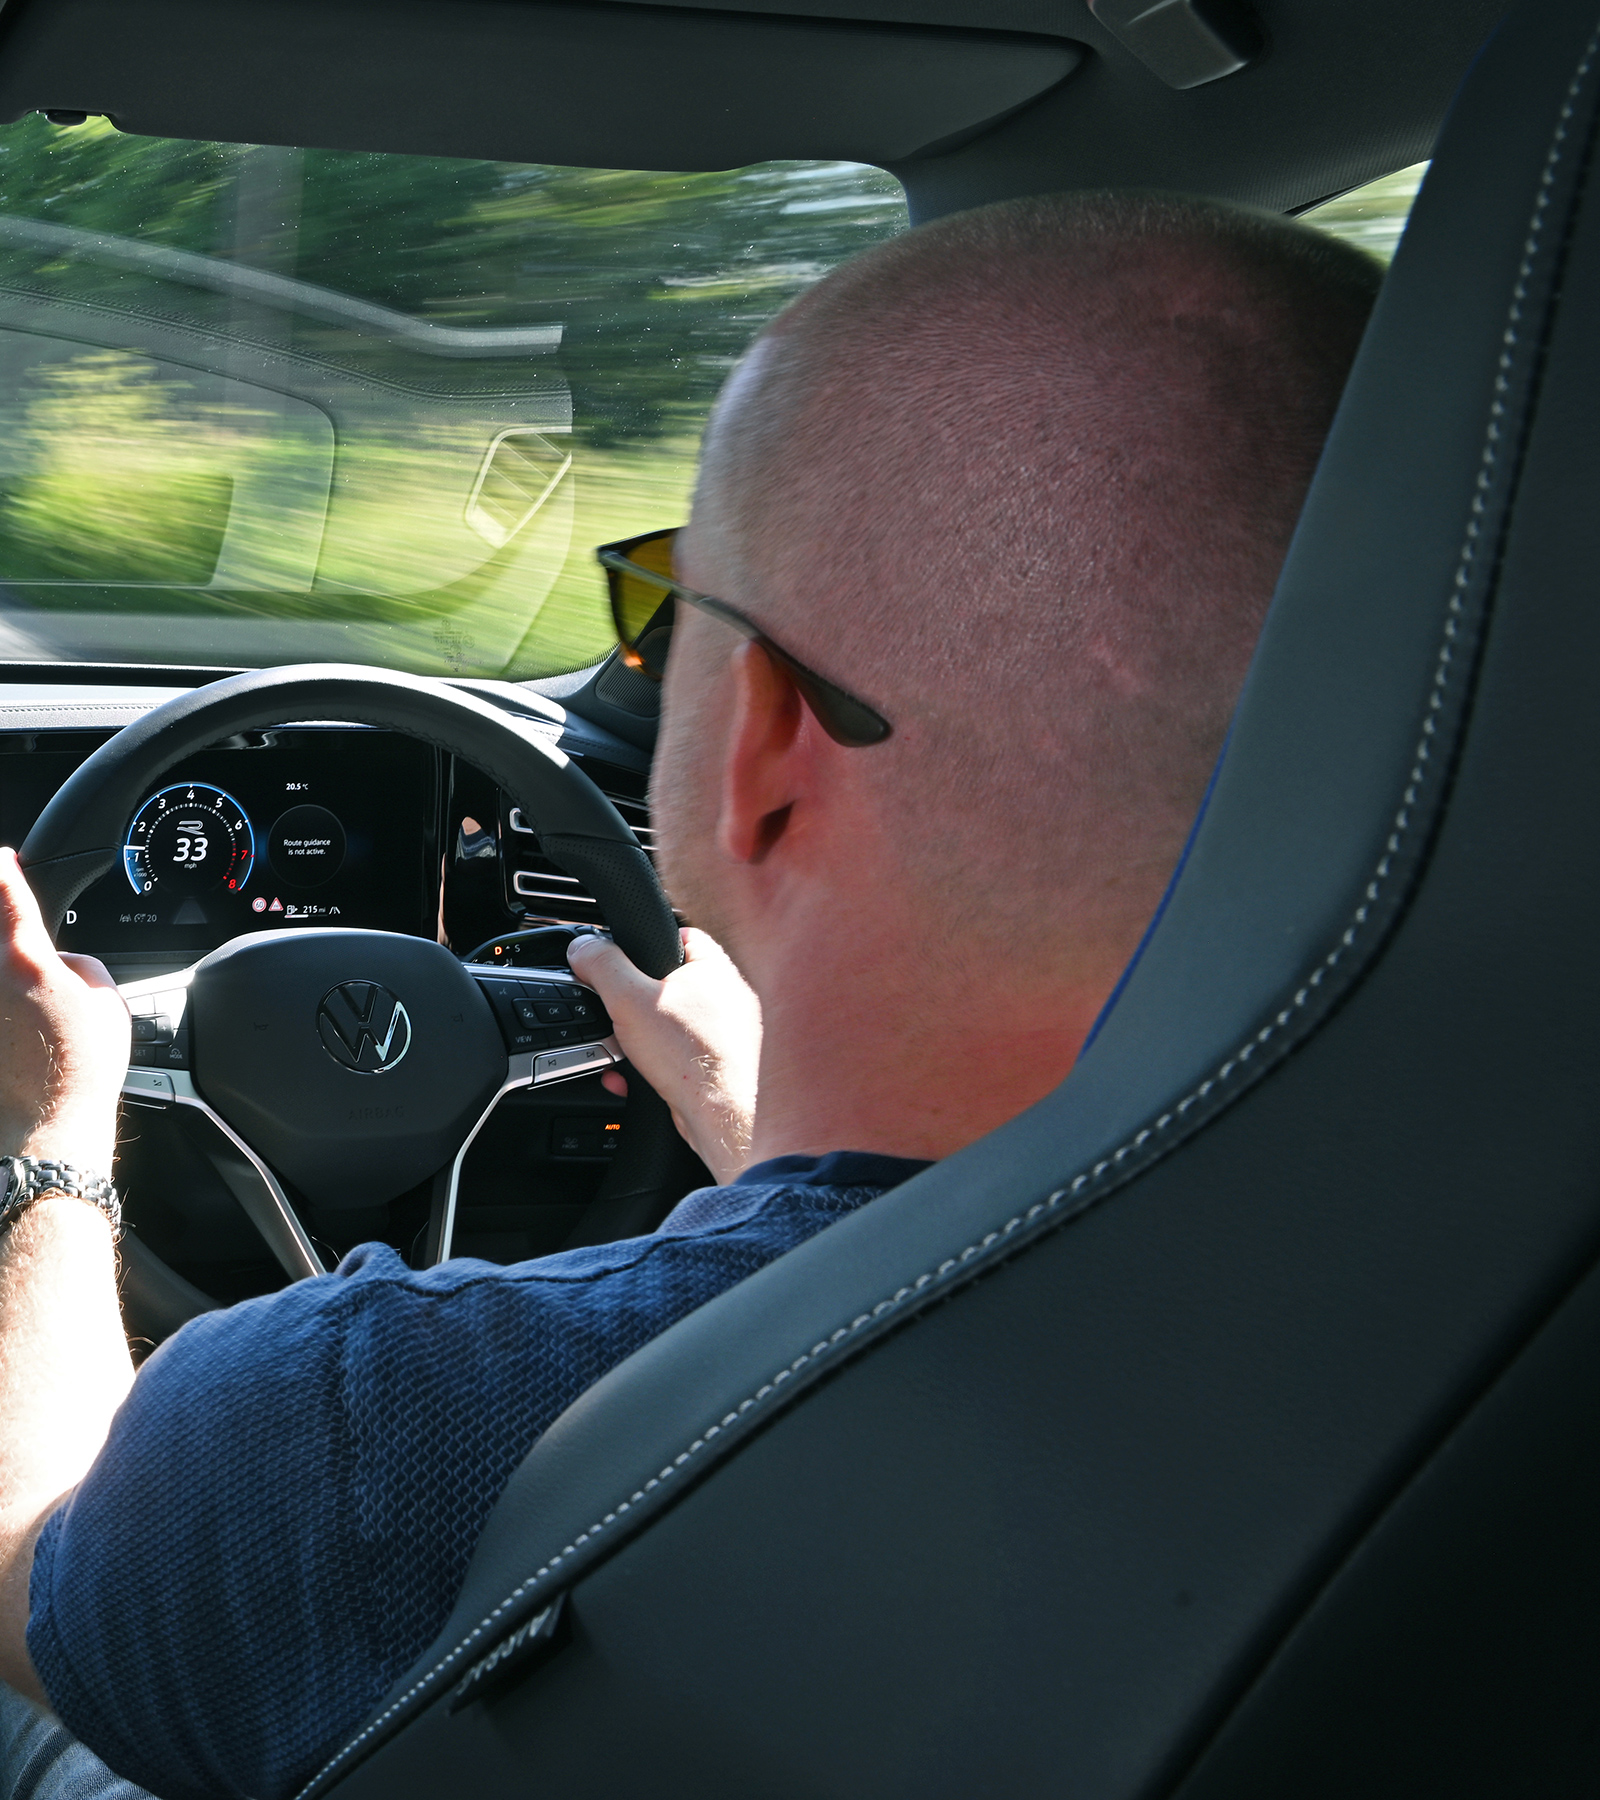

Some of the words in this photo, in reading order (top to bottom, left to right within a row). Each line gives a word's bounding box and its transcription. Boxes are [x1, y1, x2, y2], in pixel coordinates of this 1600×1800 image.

[286, 783, 301, 791] 20.5
[186, 789, 195, 800] 4
[158, 798, 166, 809] 3
[215, 797, 223, 808] 5
[137, 821, 146, 833] 2
[234, 819, 243, 830] 6
[283, 838, 302, 846] Route
[303, 838, 331, 848] guidance
[172, 837, 209, 862] 33
[240, 849, 249, 860] 7
[134, 852, 140, 863] 1
[143, 880, 152, 891] 0
[228, 879, 237, 889] 8
[303, 905, 318, 913] 215
[66, 910, 77, 924] D
[147, 914, 157, 922] 20
[494, 945, 503, 956] D
[514, 942, 521, 953] S
[515, 1035, 532, 1043] VIEW
[133, 1049, 146, 1057] SET
[604, 1123, 621, 1131] AUTO
